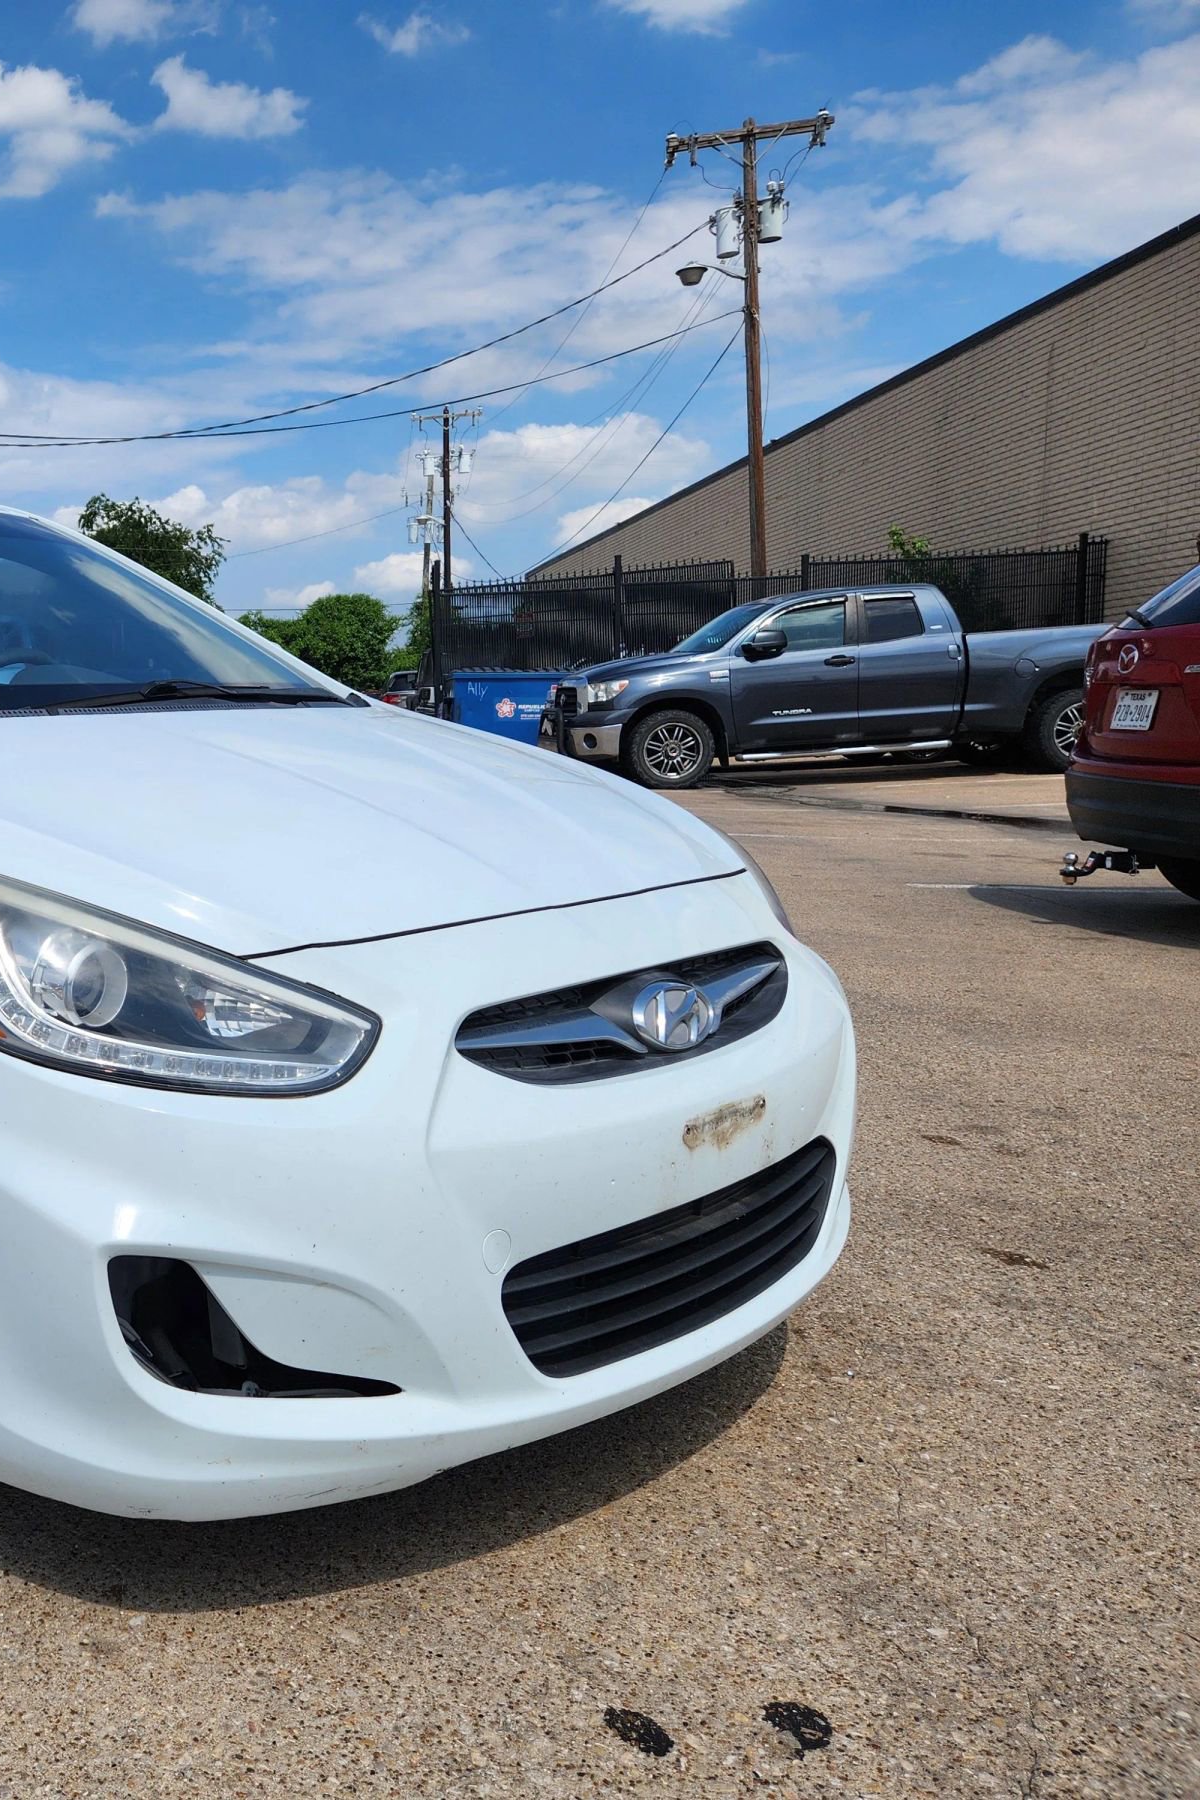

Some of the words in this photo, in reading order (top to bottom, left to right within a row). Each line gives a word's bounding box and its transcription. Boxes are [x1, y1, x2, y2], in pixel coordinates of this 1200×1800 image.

[467, 681, 488, 702] Ally
[1130, 692, 1147, 702] TEXAS
[771, 708, 813, 716] TUNDRA
